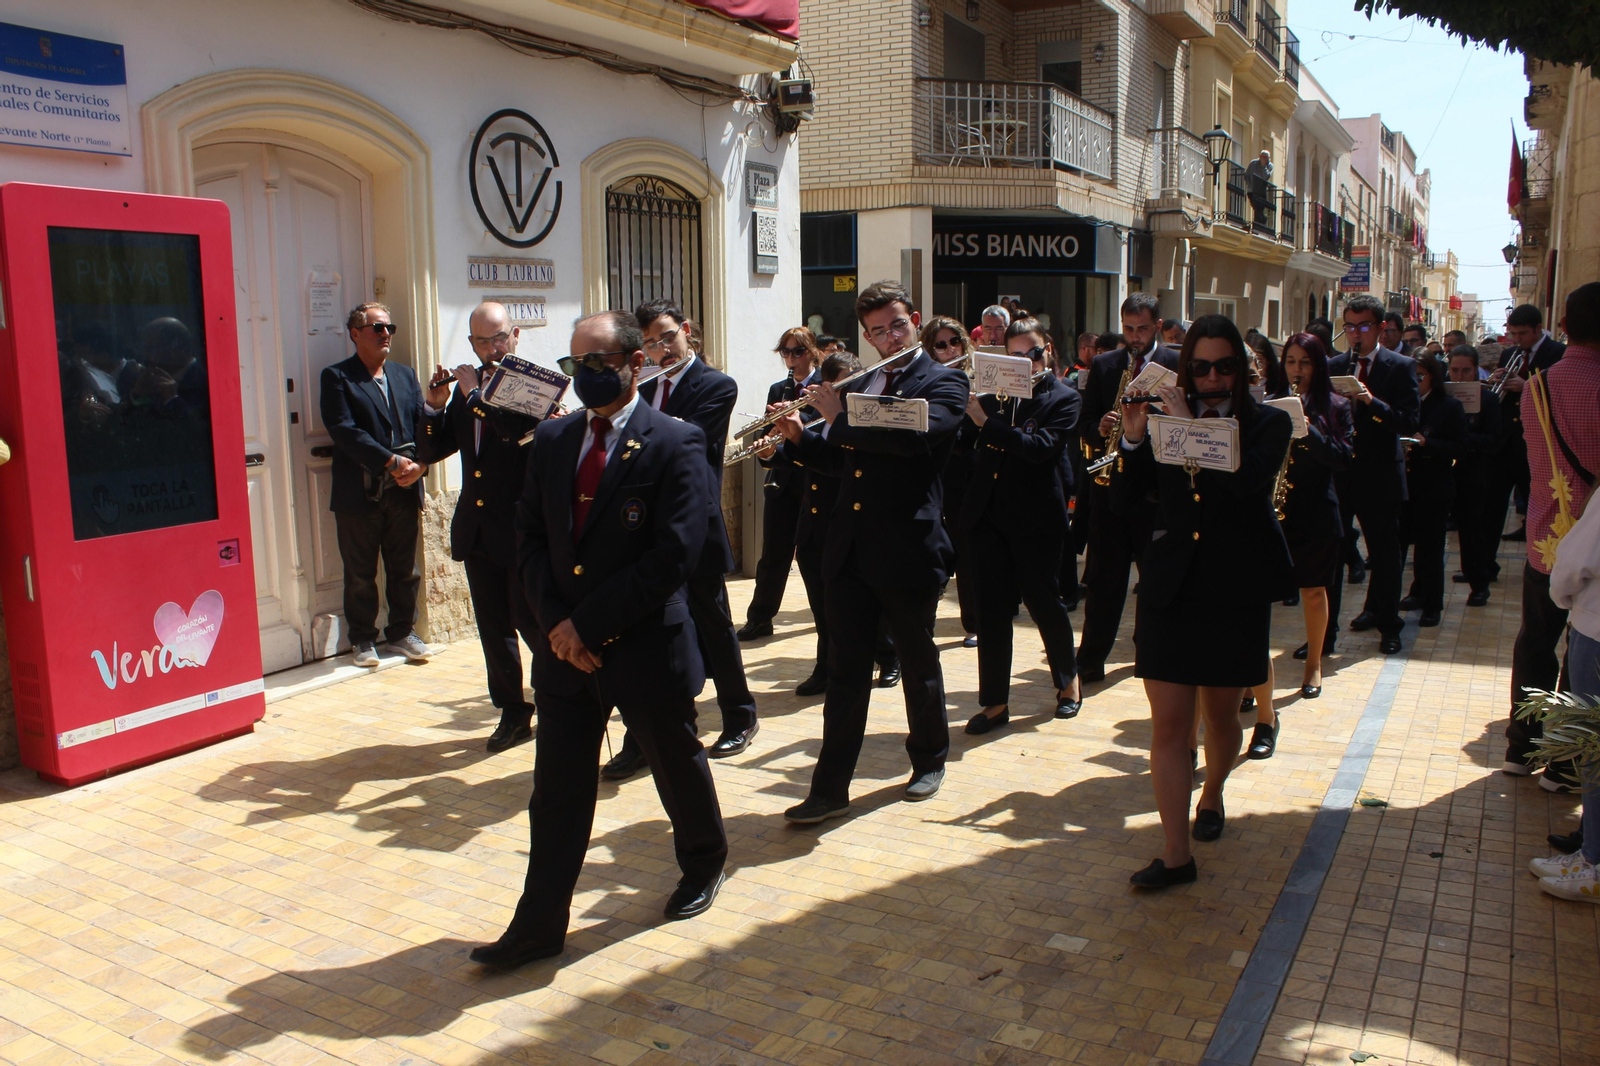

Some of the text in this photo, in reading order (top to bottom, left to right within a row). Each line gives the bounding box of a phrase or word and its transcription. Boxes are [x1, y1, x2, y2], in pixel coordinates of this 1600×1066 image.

[35, 86, 51, 99] de
[54, 89, 110, 108] Servicios
[33, 100, 121, 122] Comunitarios
[40, 129, 71, 142] Norte
[754, 172, 770, 187] Plaza
[987, 234, 1079, 258] BIANKO
[76, 259, 170, 287] PLAYAS
[469, 263, 554, 282] CLUB TAURINO
[506, 355, 570, 381] BANDA MUNICIPAL
[515, 364, 526, 372] DE
[1188, 431, 1210, 439] BANDA
[1195, 438, 1229, 448] MUNICIPAL
[131, 478, 190, 498] TOCA LA
[127, 495, 197, 516] PANTALLA
[176, 614, 208, 634] CORAZÓN
[176, 623, 215, 643] DEL LEVANTE
[91, 641, 199, 690] Vera
